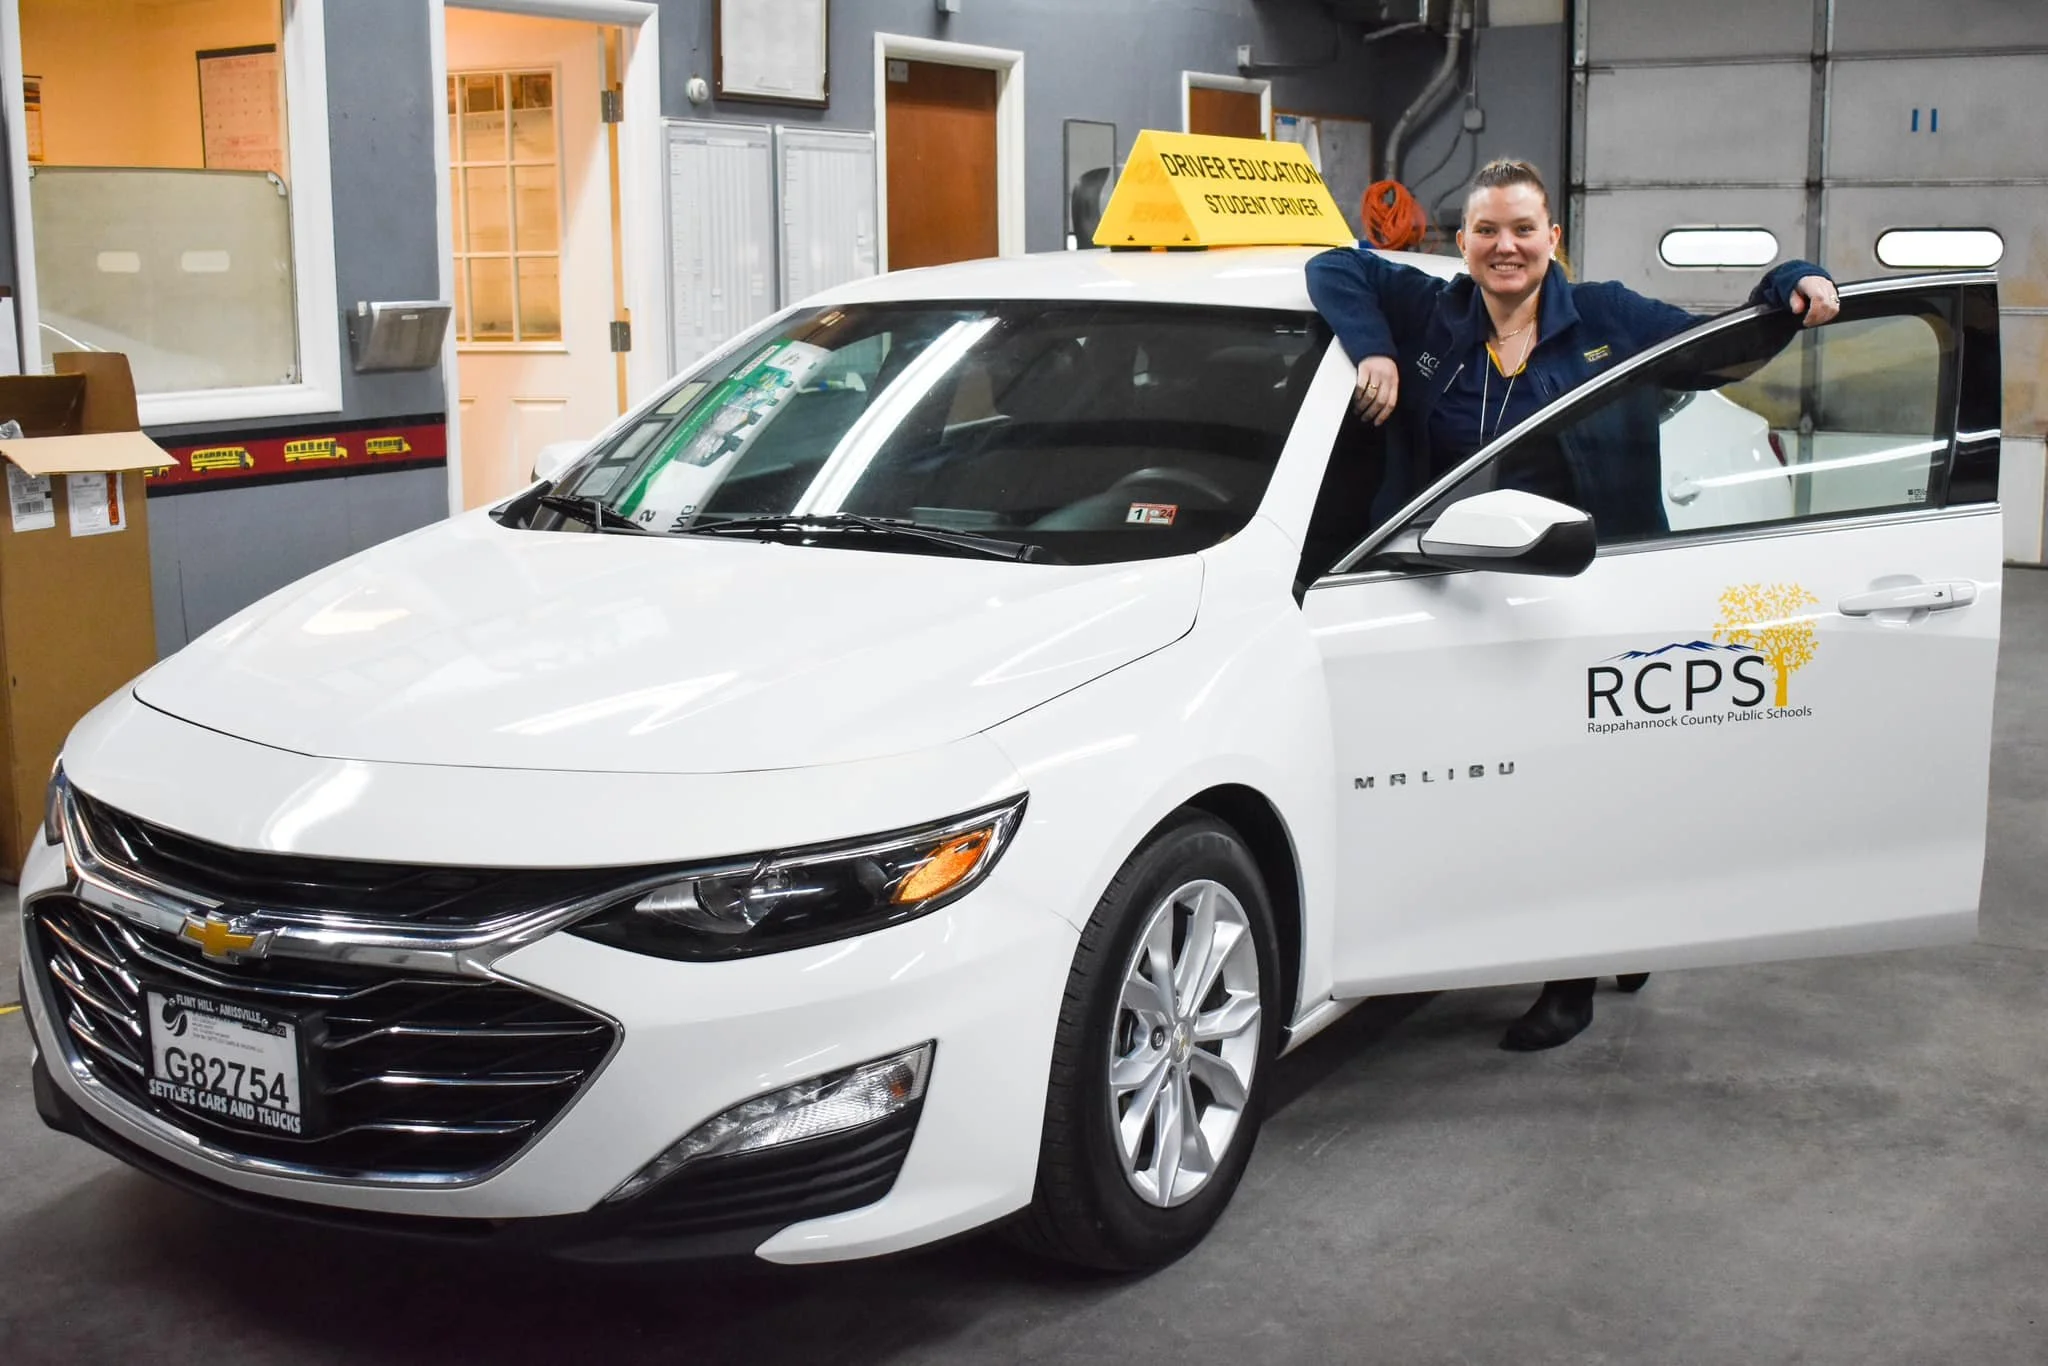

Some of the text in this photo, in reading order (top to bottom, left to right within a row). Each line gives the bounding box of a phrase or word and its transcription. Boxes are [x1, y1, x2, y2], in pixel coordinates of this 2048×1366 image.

[1160, 152, 1322, 185] DRIVER EDUCATION
[1204, 194, 1269, 216] STUDENT
[1271, 198, 1324, 217] DRIVER
[1134, 508, 1144, 520] 1
[1587, 655, 1766, 719] RCPS
[1587, 705, 1813, 735] Rappahannock County Public Schools
[1354, 761, 1515, 790] MALIBU
[176, 994, 196, 1008] FLINT
[197, 999, 214, 1013] HILL
[219, 1003, 262, 1023] AMISSVILLE
[164, 1046, 290, 1110] G82754
[198, 1090, 228, 1114] CARS
[229, 1099, 256, 1120] AND
[257, 1107, 301, 1134] TRUCKS
